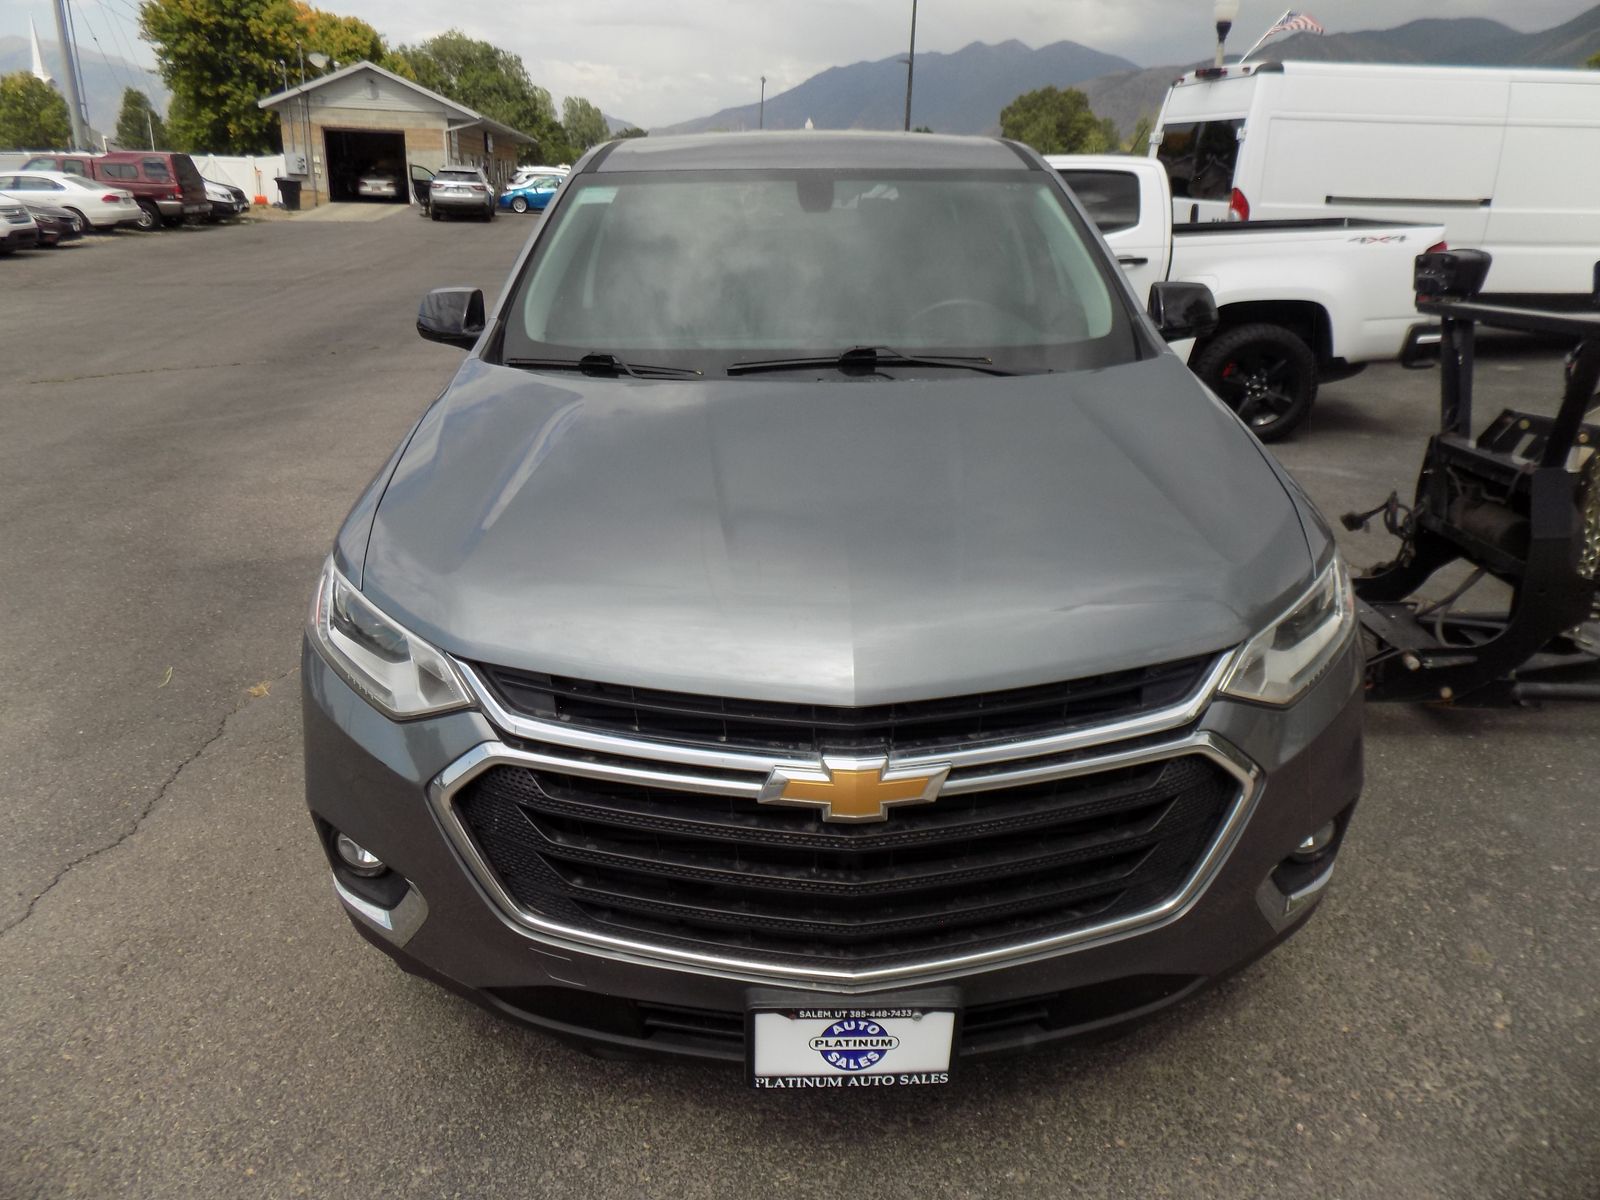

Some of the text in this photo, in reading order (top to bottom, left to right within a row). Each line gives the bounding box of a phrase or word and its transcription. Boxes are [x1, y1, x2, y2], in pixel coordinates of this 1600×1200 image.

[835, 1010, 847, 1018] UT
[832, 1021, 880, 1035] AUTO
[814, 1039, 893, 1048] PLATINUM
[827, 1051, 880, 1069] SALES
[755, 1073, 949, 1088] PLATINUM AUTO SALES
